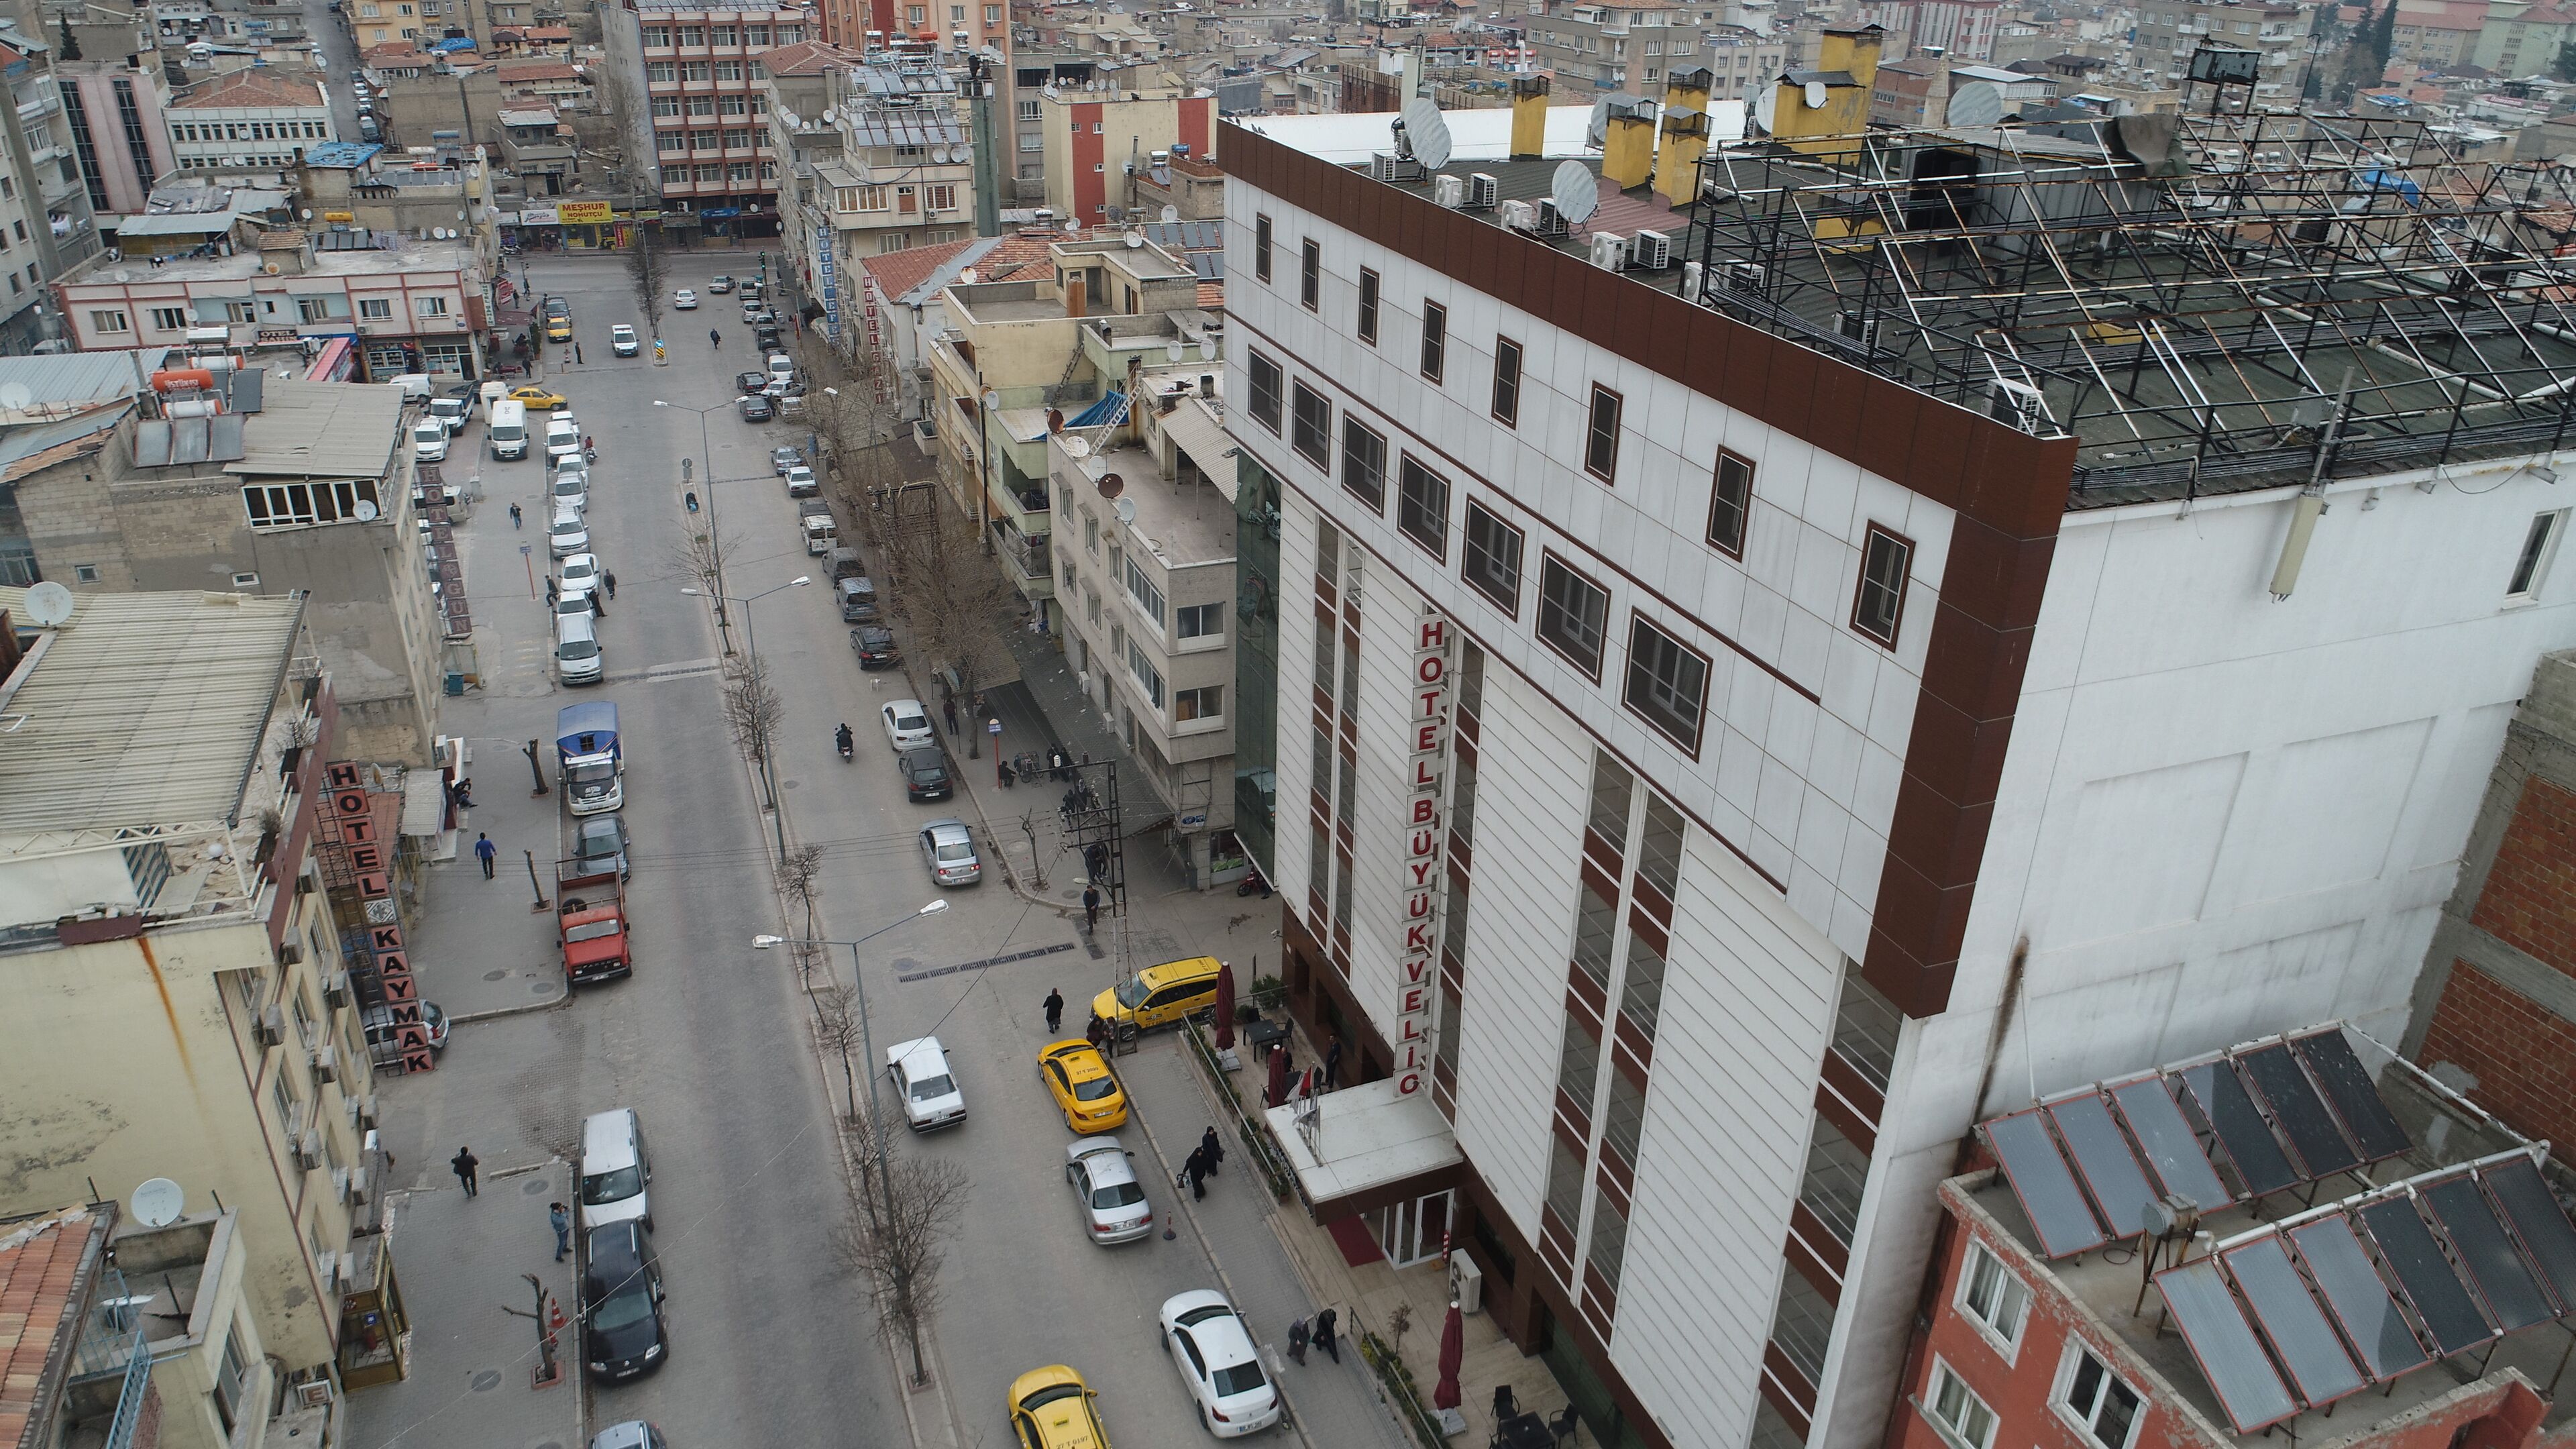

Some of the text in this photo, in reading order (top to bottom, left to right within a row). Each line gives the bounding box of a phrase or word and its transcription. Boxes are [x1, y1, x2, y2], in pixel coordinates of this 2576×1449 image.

[562, 203, 605, 212] MEŞHUR
[819, 227, 839, 345] HOTEL EFES
[864, 277, 878, 344] HOTEL
[424, 470, 453, 557] HOTEL
[1417, 621, 1442, 783] HOTEL
[331, 766, 429, 1072] HOTEL KAYMAK
[1407, 799, 1433, 947] BÜYÜK
